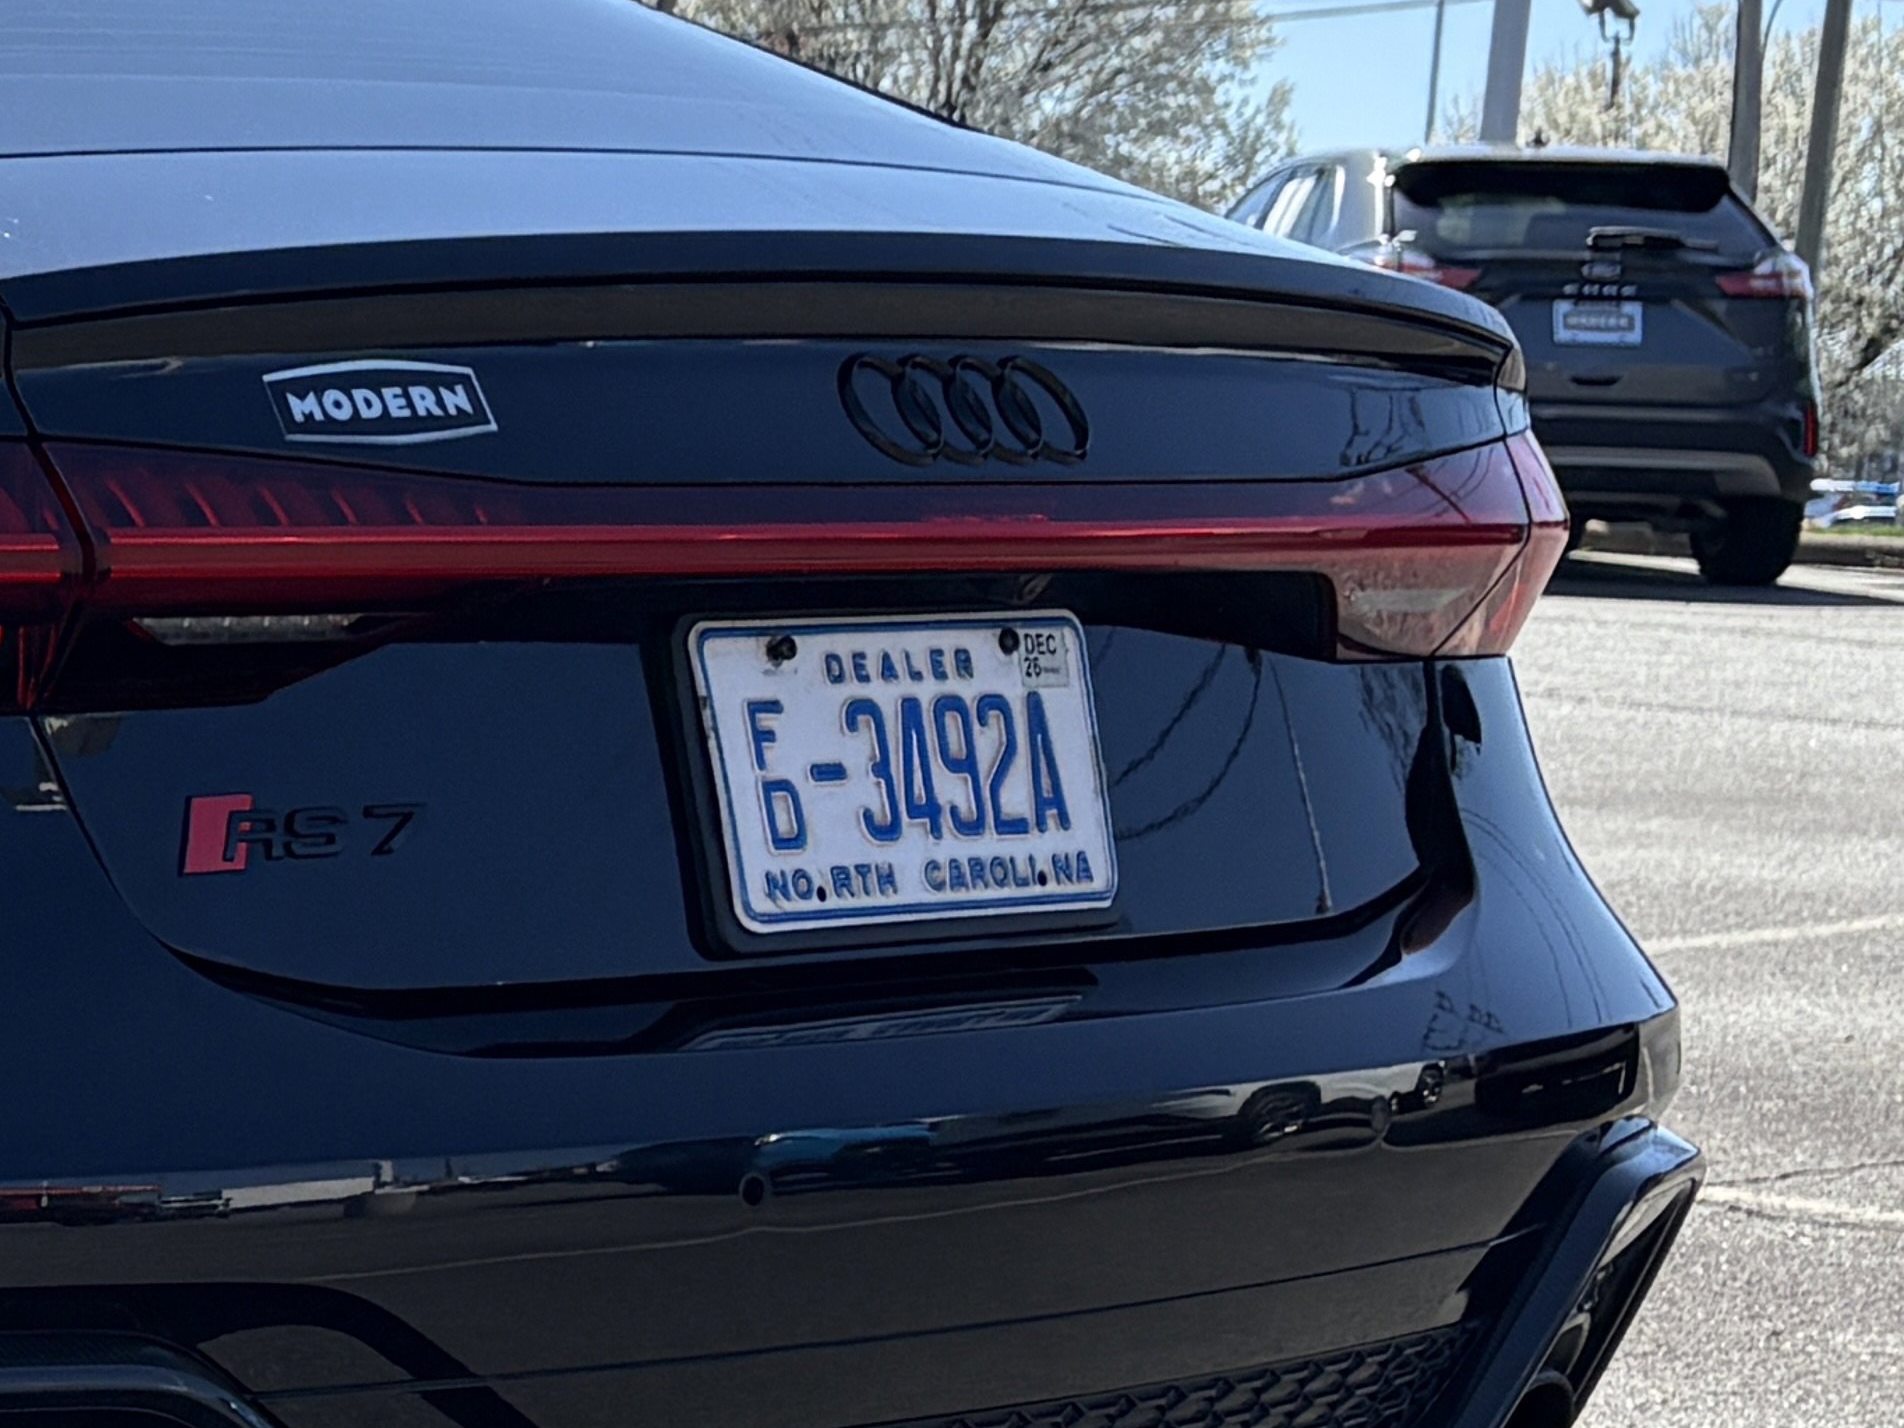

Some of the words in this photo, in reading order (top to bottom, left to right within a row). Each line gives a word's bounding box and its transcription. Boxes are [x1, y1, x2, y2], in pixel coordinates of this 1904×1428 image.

[286, 384, 473, 422] MODERN
[1024, 633, 1057, 655] DEC
[824, 647, 975, 685] DEALER
[765, 863, 898, 904] NORTH
[923, 851, 1095, 893] CAROLINA
